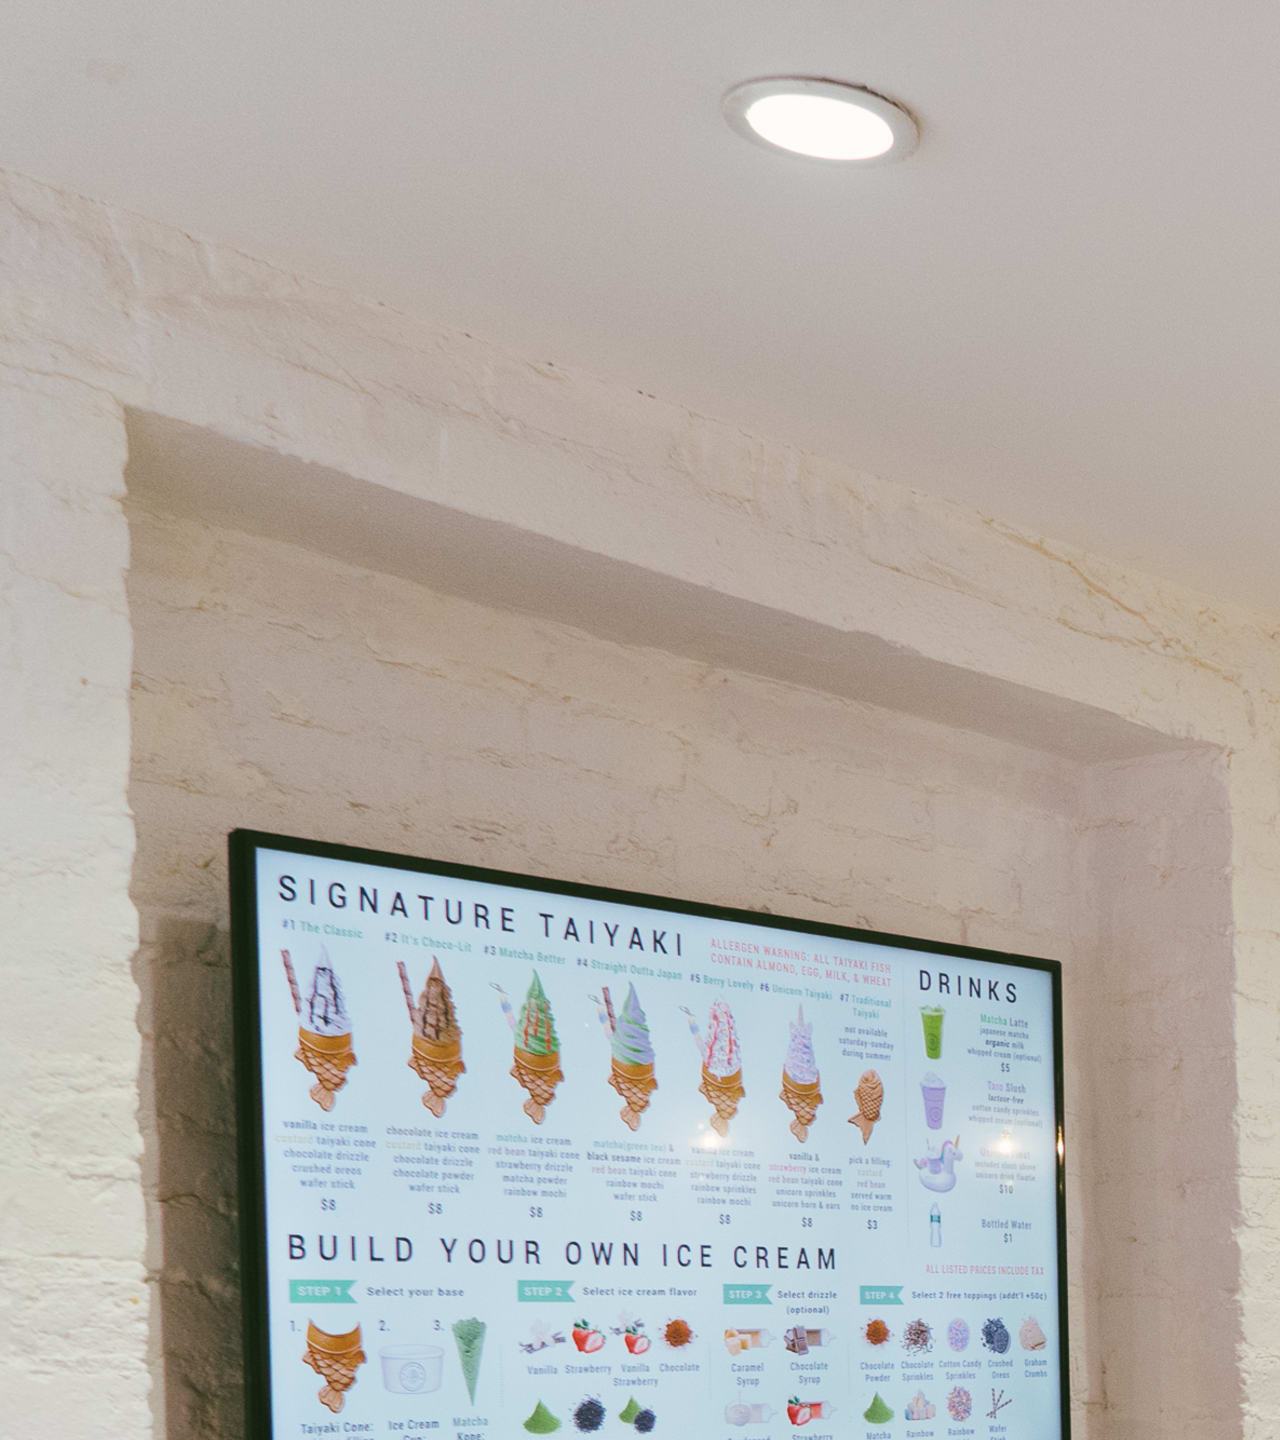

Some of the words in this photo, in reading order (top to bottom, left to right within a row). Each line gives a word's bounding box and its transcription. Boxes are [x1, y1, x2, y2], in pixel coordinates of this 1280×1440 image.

[279, 875, 516, 933] SIGNATURE
[539, 913, 682, 956] TAIYAKI
[282, 918, 296, 931] #1
[300, 920, 320, 935] The
[323, 923, 364, 939] Classic
[385, 931, 398, 943] #2
[484, 944, 497, 956] #3
[499, 946, 533, 962] Matcha
[536, 949, 566, 965] Better
[710, 938, 760, 957] ALLERGEN
[813, 952, 831, 965] ALL
[833, 955, 868, 970] TAIYAKI
[870, 960, 892, 972] FISH
[576, 957, 589, 968] #4
[591, 958, 627, 975] Straight
[630, 964, 654, 977] Outta
[656, 966, 682, 981] Japan
[711, 953, 753, 970] CONTAIN
[862, 974, 892, 987] WHEAT
[690, 974, 701, 983] #5
[703, 974, 725, 989] Berry
[727, 977, 754, 992] Lovely
[919, 969, 1018, 1004] DRINKS
[760, 981, 770, 992] #6
[772, 984, 802, 997] Unicorn
[804, 987, 833, 1001] Taiyaki
[840, 993, 850, 1002] #7
[852, 995, 892, 1008] Traditional
[853, 1007, 880, 1019] Taiyaki
[980, 1013, 1007, 1026] Matcha
[1009, 1017, 1029, 1029] Latte
[1000, 1062, 1011, 1073] $5
[320, 1121, 333, 1132] ice
[336, 1123, 369, 1134] cream
[320, 1198, 337, 1212] $8
[427, 1202, 444, 1215] $8
[529, 1206, 544, 1219] $8
[629, 1209, 643, 1222] $8
[719, 1213, 731, 1226] $8
[801, 1216, 813, 1228] $8
[866, 1219, 878, 1230] $3
[981, 1218, 1008, 1230] Bottled
[1010, 1219, 1032, 1231] Water
[288, 1233, 414, 1263] BUILD
[440, 1237, 542, 1265] YOUR
[565, 1241, 640, 1267] OWN
[662, 1243, 713, 1269] ICE
[733, 1245, 837, 1270] CREAM
[925, 1264, 940, 1274] ALL
[297, 1285, 332, 1296] STEP
[367, 1286, 405, 1297] Select
[409, 1288, 437, 1299] your
[440, 1286, 465, 1297] base
[524, 1286, 553, 1296] STEP
[583, 1286, 614, 1297] Select
[617, 1286, 633, 1297] ice
[636, 1288, 665, 1297] cream
[668, 1287, 697, 1298] flavor
[728, 1290, 753, 1300] STEP
[777, 1289, 805, 1300] Select
[807, 1289, 838, 1300] drizzle
[864, 1290, 887, 1300] STEP
[912, 1290, 934, 1300] Select
[946, 1291, 961, 1300] free
[963, 1291, 997, 1302] toppings
[786, 1304, 830, 1316] (optional)
[388, 1418, 404, 1431] Ice
[407, 1418, 440, 1431] Cream
[452, 1415, 489, 1428] Matcha
[300, 1422, 339, 1436] Taiyaki
